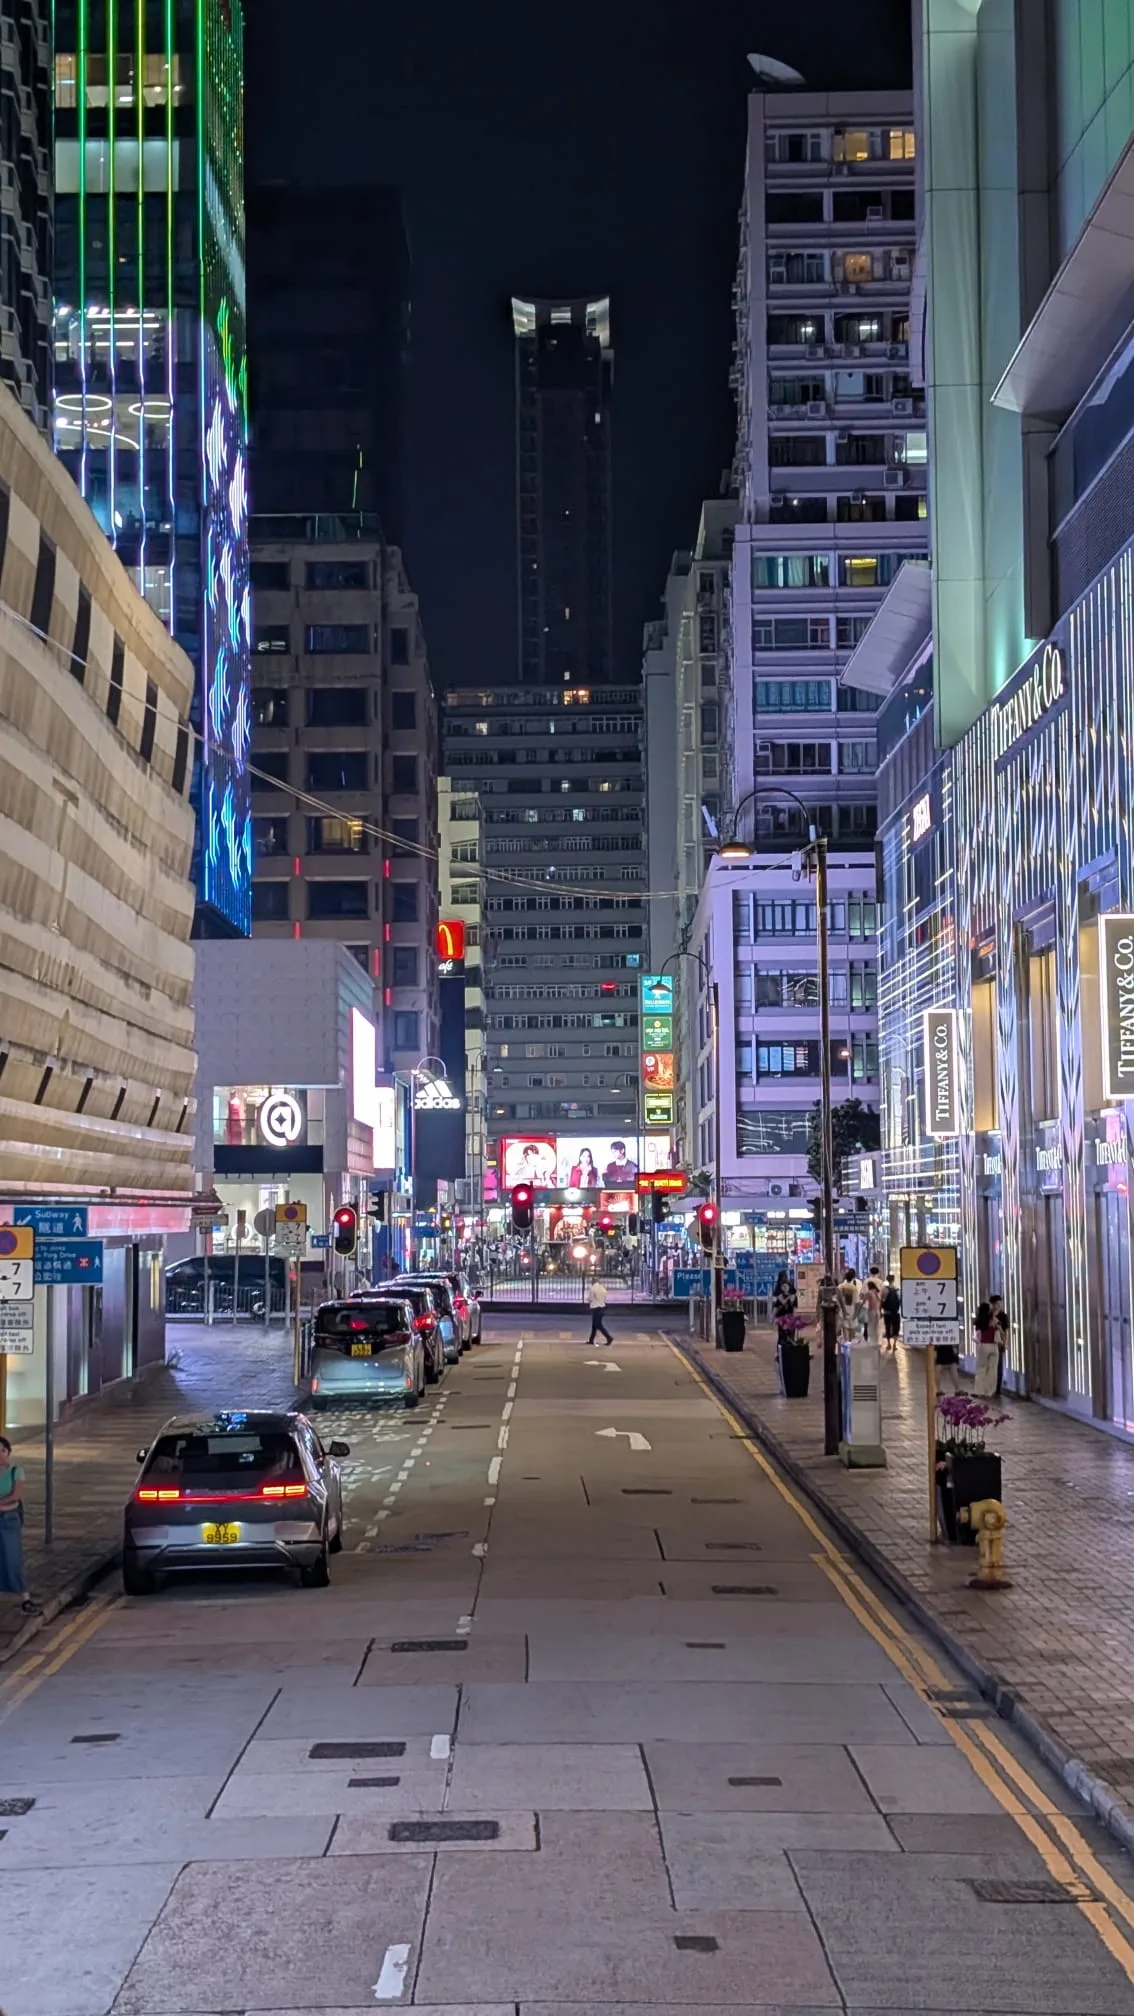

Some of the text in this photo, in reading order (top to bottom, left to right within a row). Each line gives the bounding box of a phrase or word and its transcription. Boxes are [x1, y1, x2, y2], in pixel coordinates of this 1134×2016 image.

[35, 1210, 70, 1219] Subway
[12, 1262, 21, 1276] 7
[12, 1282, 22, 1296] 7
[937, 1282, 946, 1296] 7
[937, 1302, 947, 1316] 7
